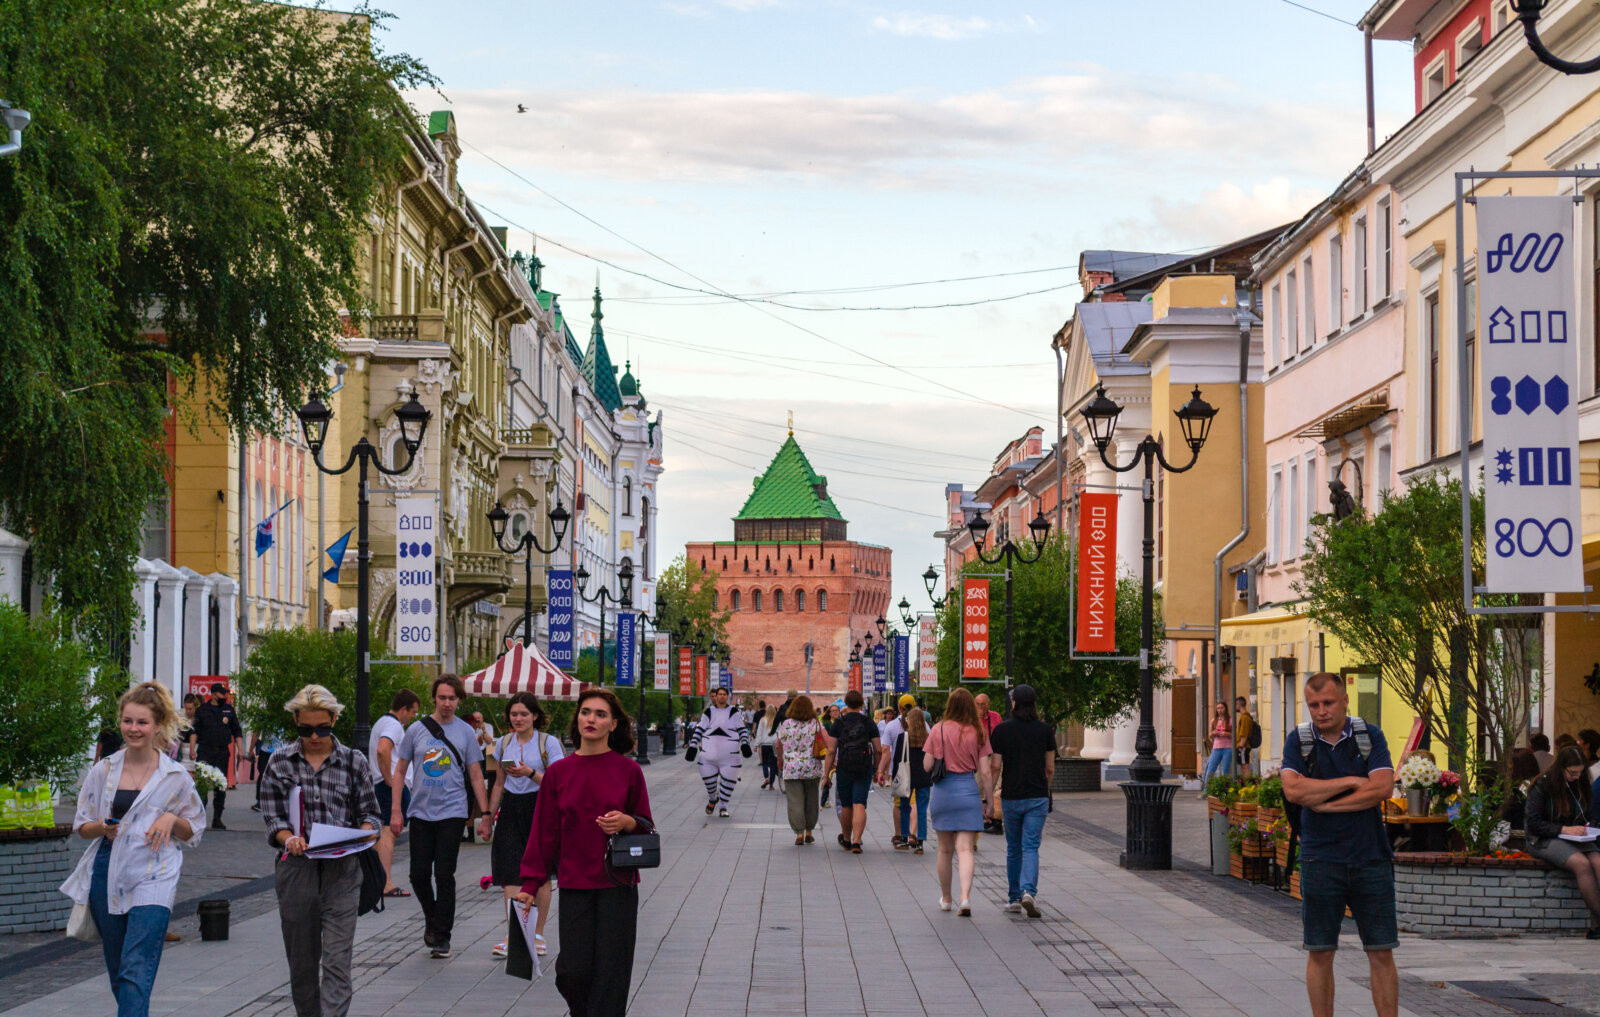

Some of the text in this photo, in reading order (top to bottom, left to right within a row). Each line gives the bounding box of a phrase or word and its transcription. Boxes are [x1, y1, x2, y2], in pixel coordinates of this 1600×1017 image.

[1490, 374, 1569, 416] 800
[1495, 518, 1573, 558] 800
[399, 542, 432, 558] 800
[400, 570, 432, 586] 800
[1088, 507, 1106, 638] НИЖНИЙ 800
[550, 579, 571, 590] 800
[551, 596, 571, 607] 800
[966, 606, 987, 616] 800
[400, 626, 431, 643] 800
[966, 623, 986, 634] 800
[550, 649, 571, 660] 800
[621, 637, 629, 678] НИЖНИЙ
[965, 658, 986, 670] 800
